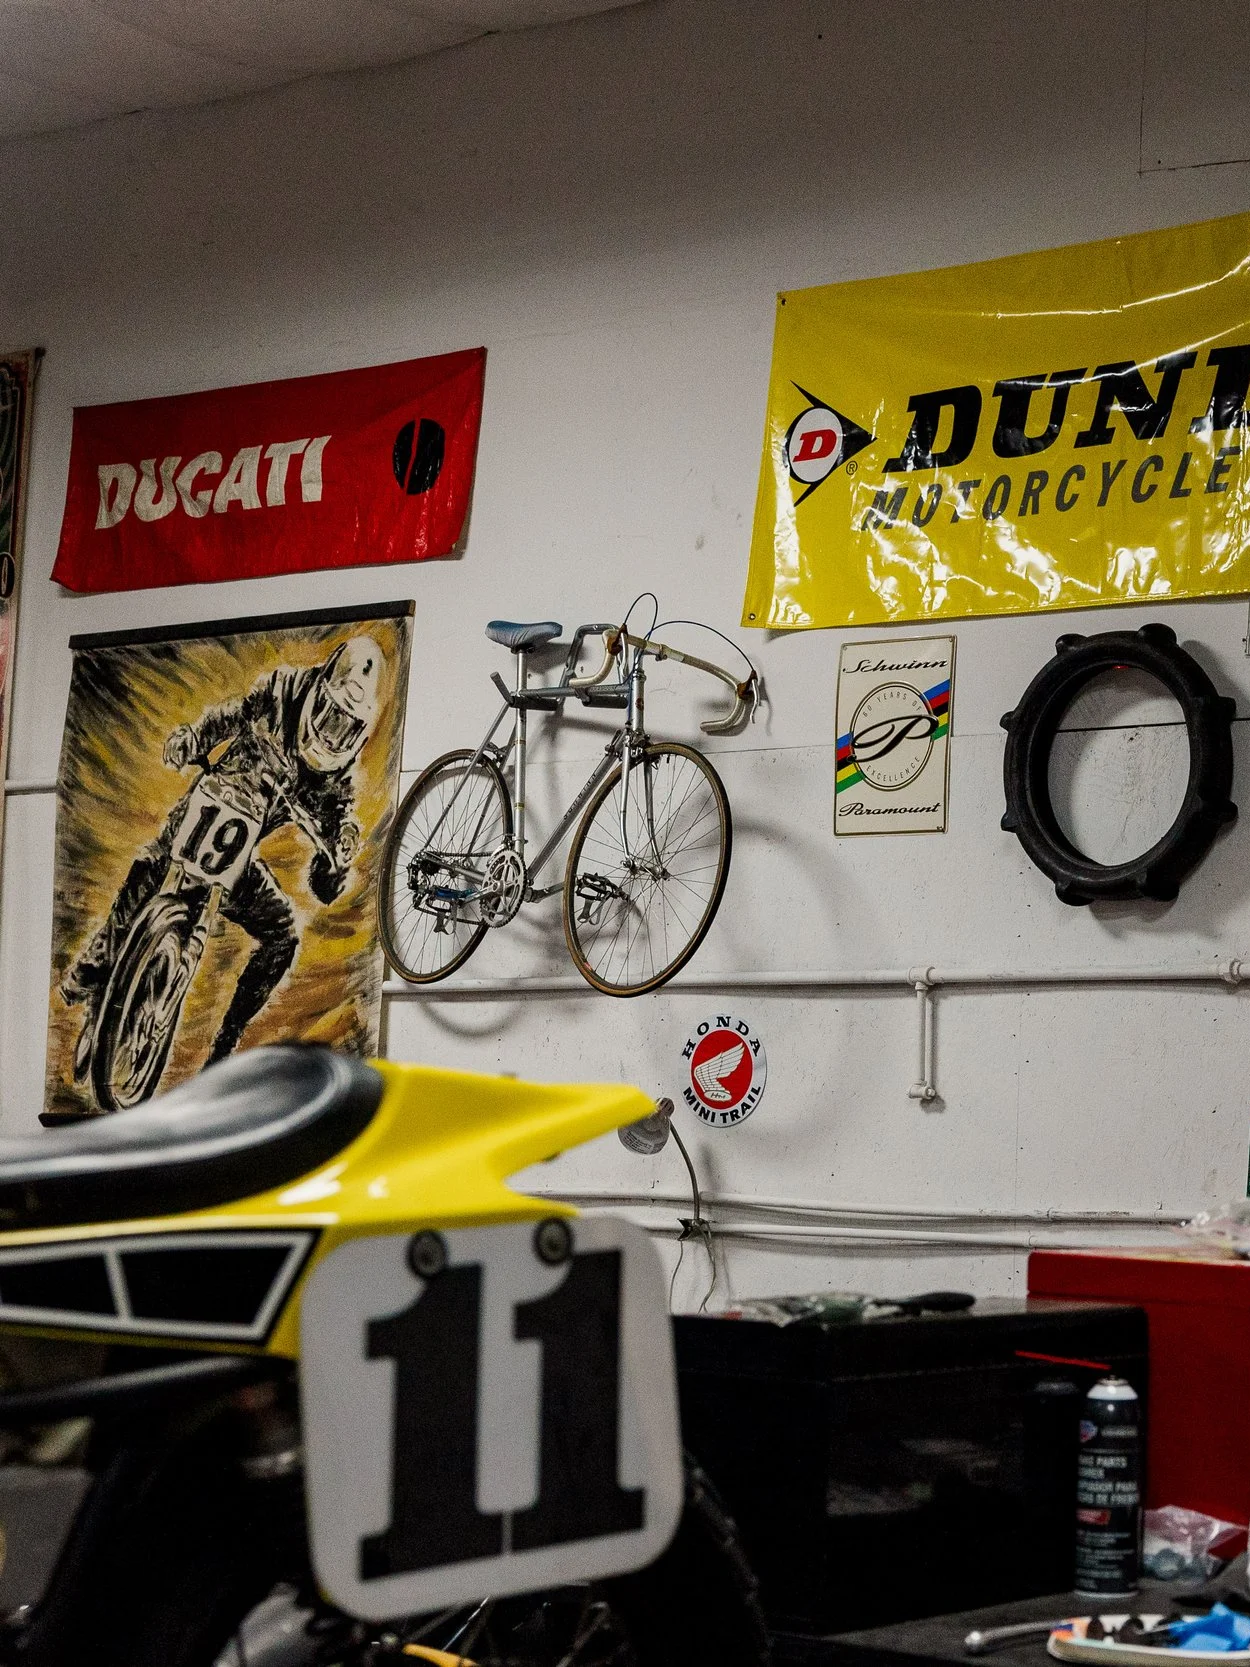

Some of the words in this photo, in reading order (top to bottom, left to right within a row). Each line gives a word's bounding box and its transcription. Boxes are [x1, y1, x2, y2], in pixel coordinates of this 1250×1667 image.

[792, 429, 837, 462] D
[95, 435, 332, 530] DUCATI
[861, 446, 1240, 531] MOTORCYCLE
[842, 658, 948, 674] Schwinn
[876, 691, 908, 703] YEARS
[911, 700, 922, 712] OF
[866, 756, 921, 782] EXCELLENCE
[838, 801, 941, 817] Paramount
[179, 804, 249, 875] 19
[681, 1016, 761, 1060] HONDA
[683, 1086, 716, 1123] MINI
[720, 1086, 761, 1124] TRAIL
[359, 1249, 647, 1582] 11
